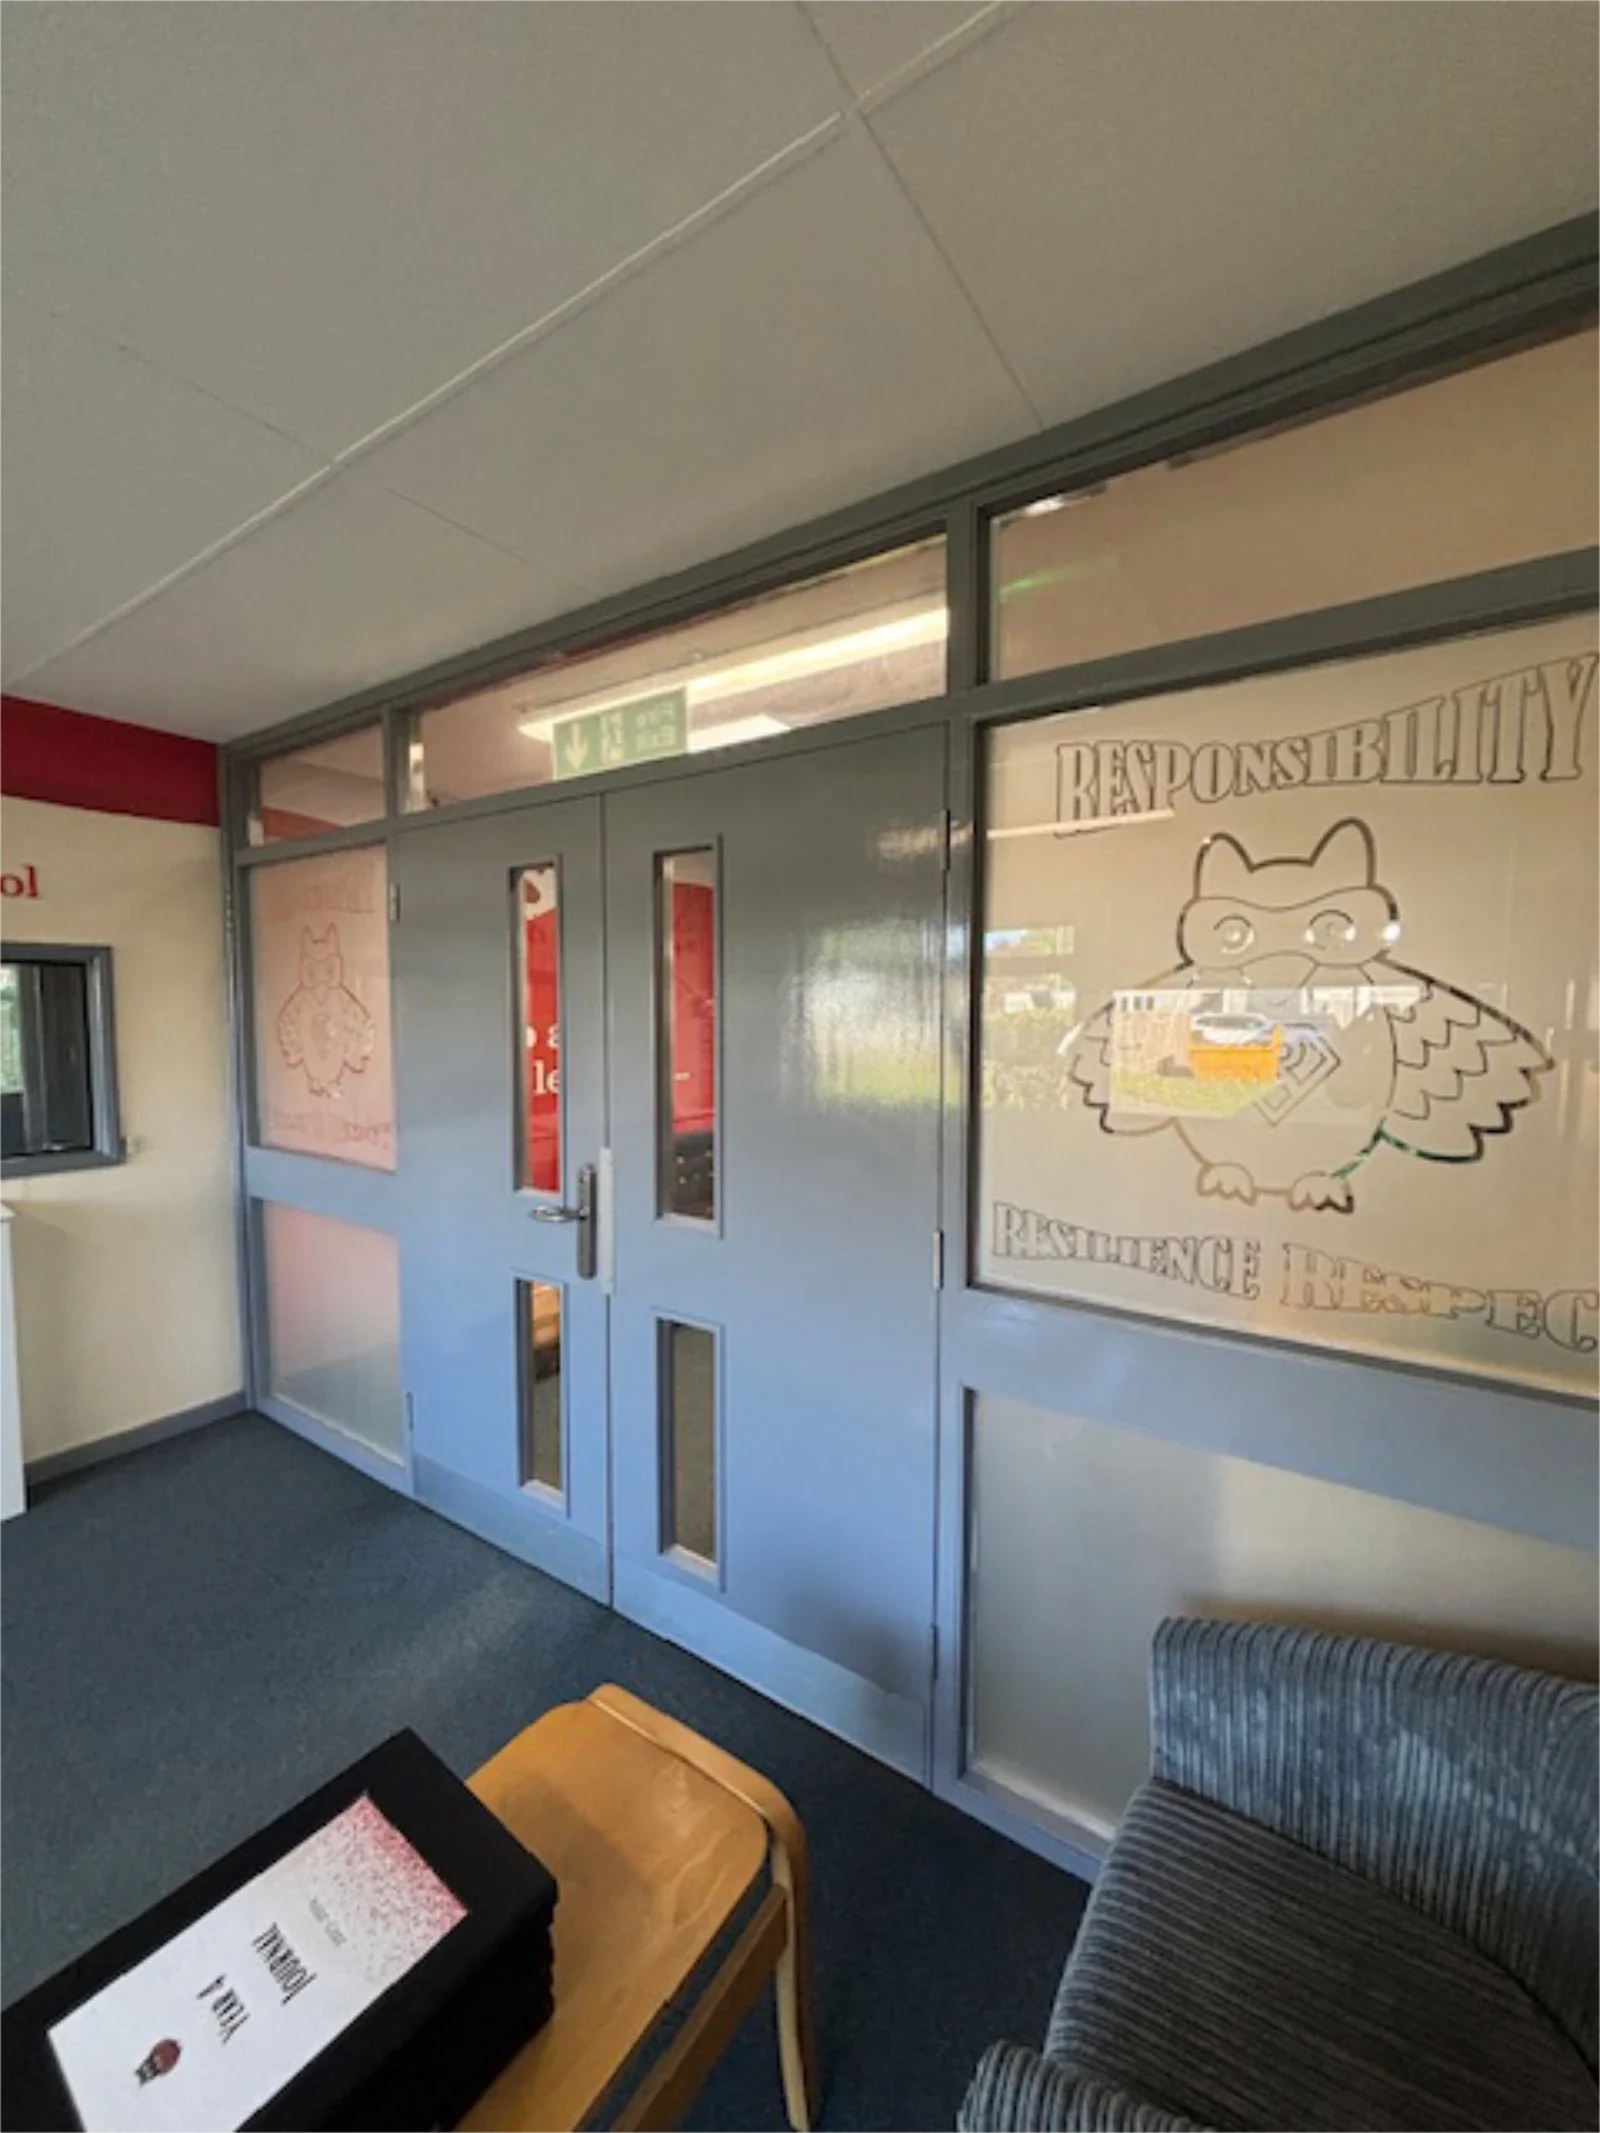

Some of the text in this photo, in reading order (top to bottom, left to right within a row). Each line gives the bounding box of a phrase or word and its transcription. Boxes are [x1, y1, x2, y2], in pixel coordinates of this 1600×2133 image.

[1053, 652, 1600, 838] RESPONSIBILITY
[0, 863, 42, 900] ol
[993, 1201, 1261, 1300] RESILIENCE
